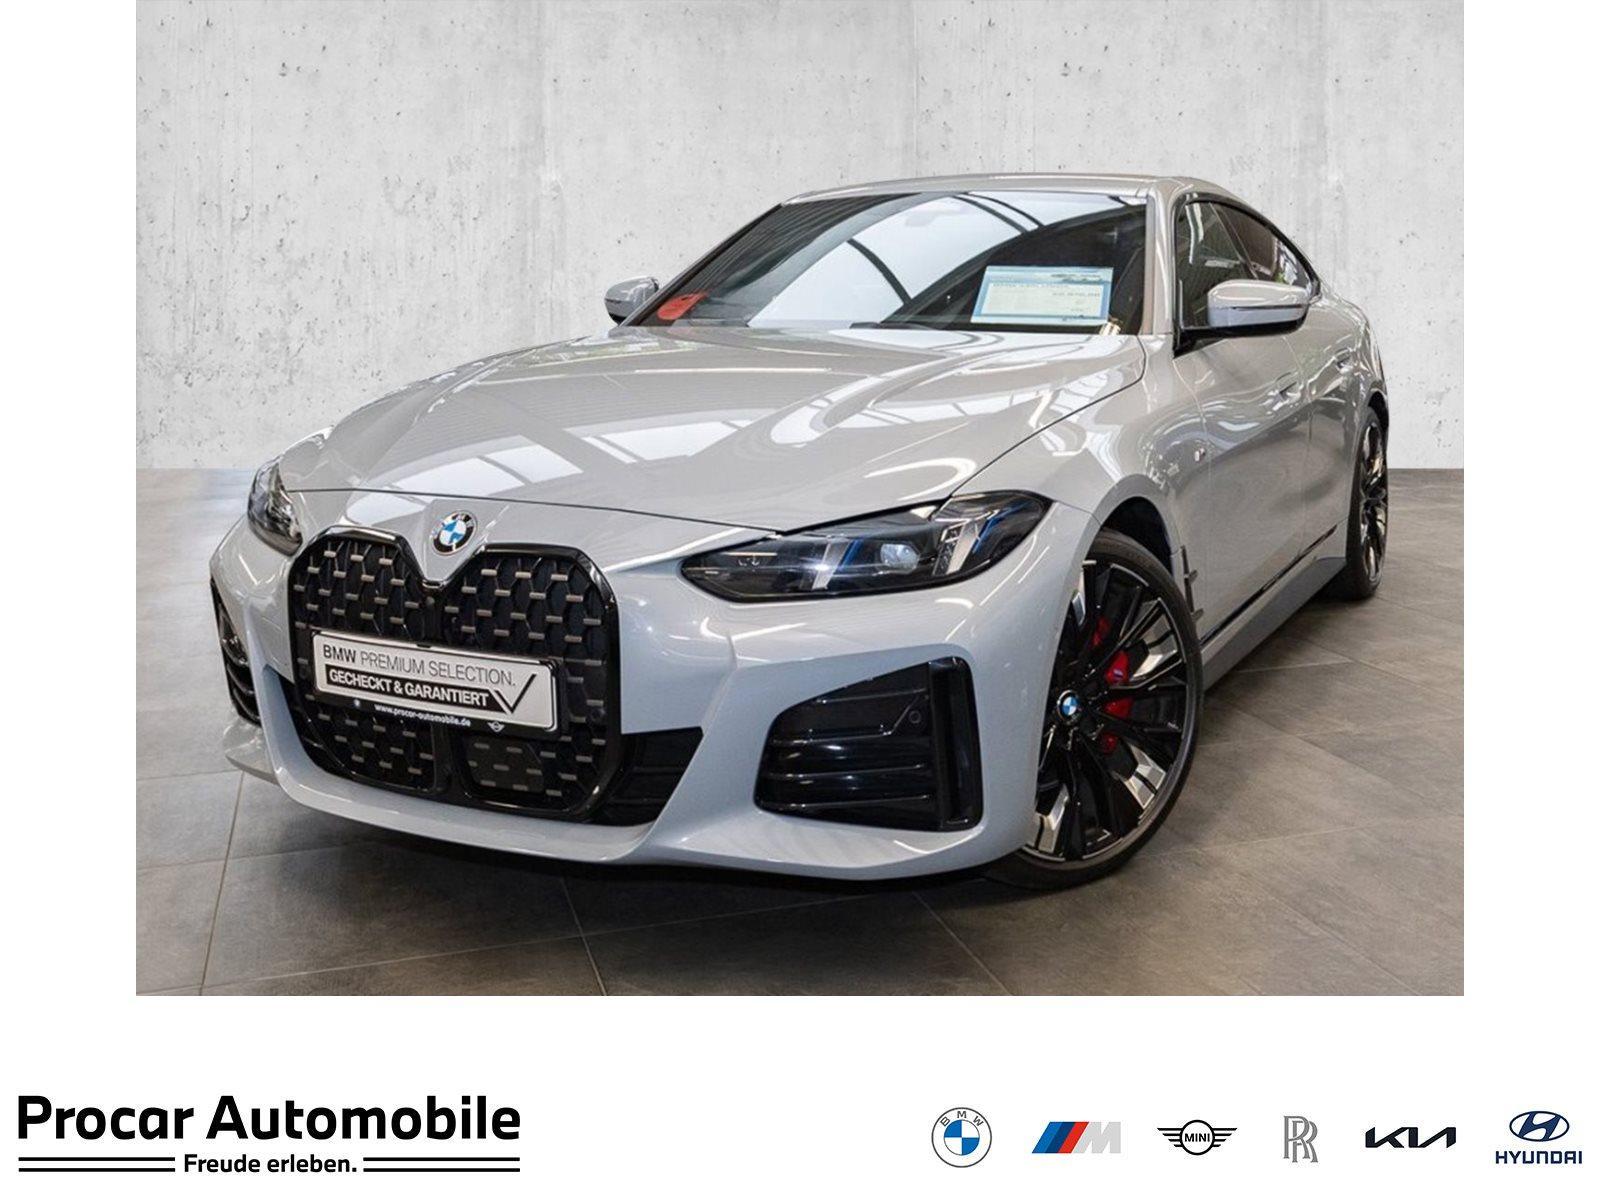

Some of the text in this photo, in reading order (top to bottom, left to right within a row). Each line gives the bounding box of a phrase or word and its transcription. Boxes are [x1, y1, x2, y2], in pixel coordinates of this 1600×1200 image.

[323, 644, 516, 687] BMW PREMIUM SELECTION.
[329, 669, 489, 707] GECHECKT & GARANTIERT
[374, 704, 471, 727] www.procar-automobile.de
